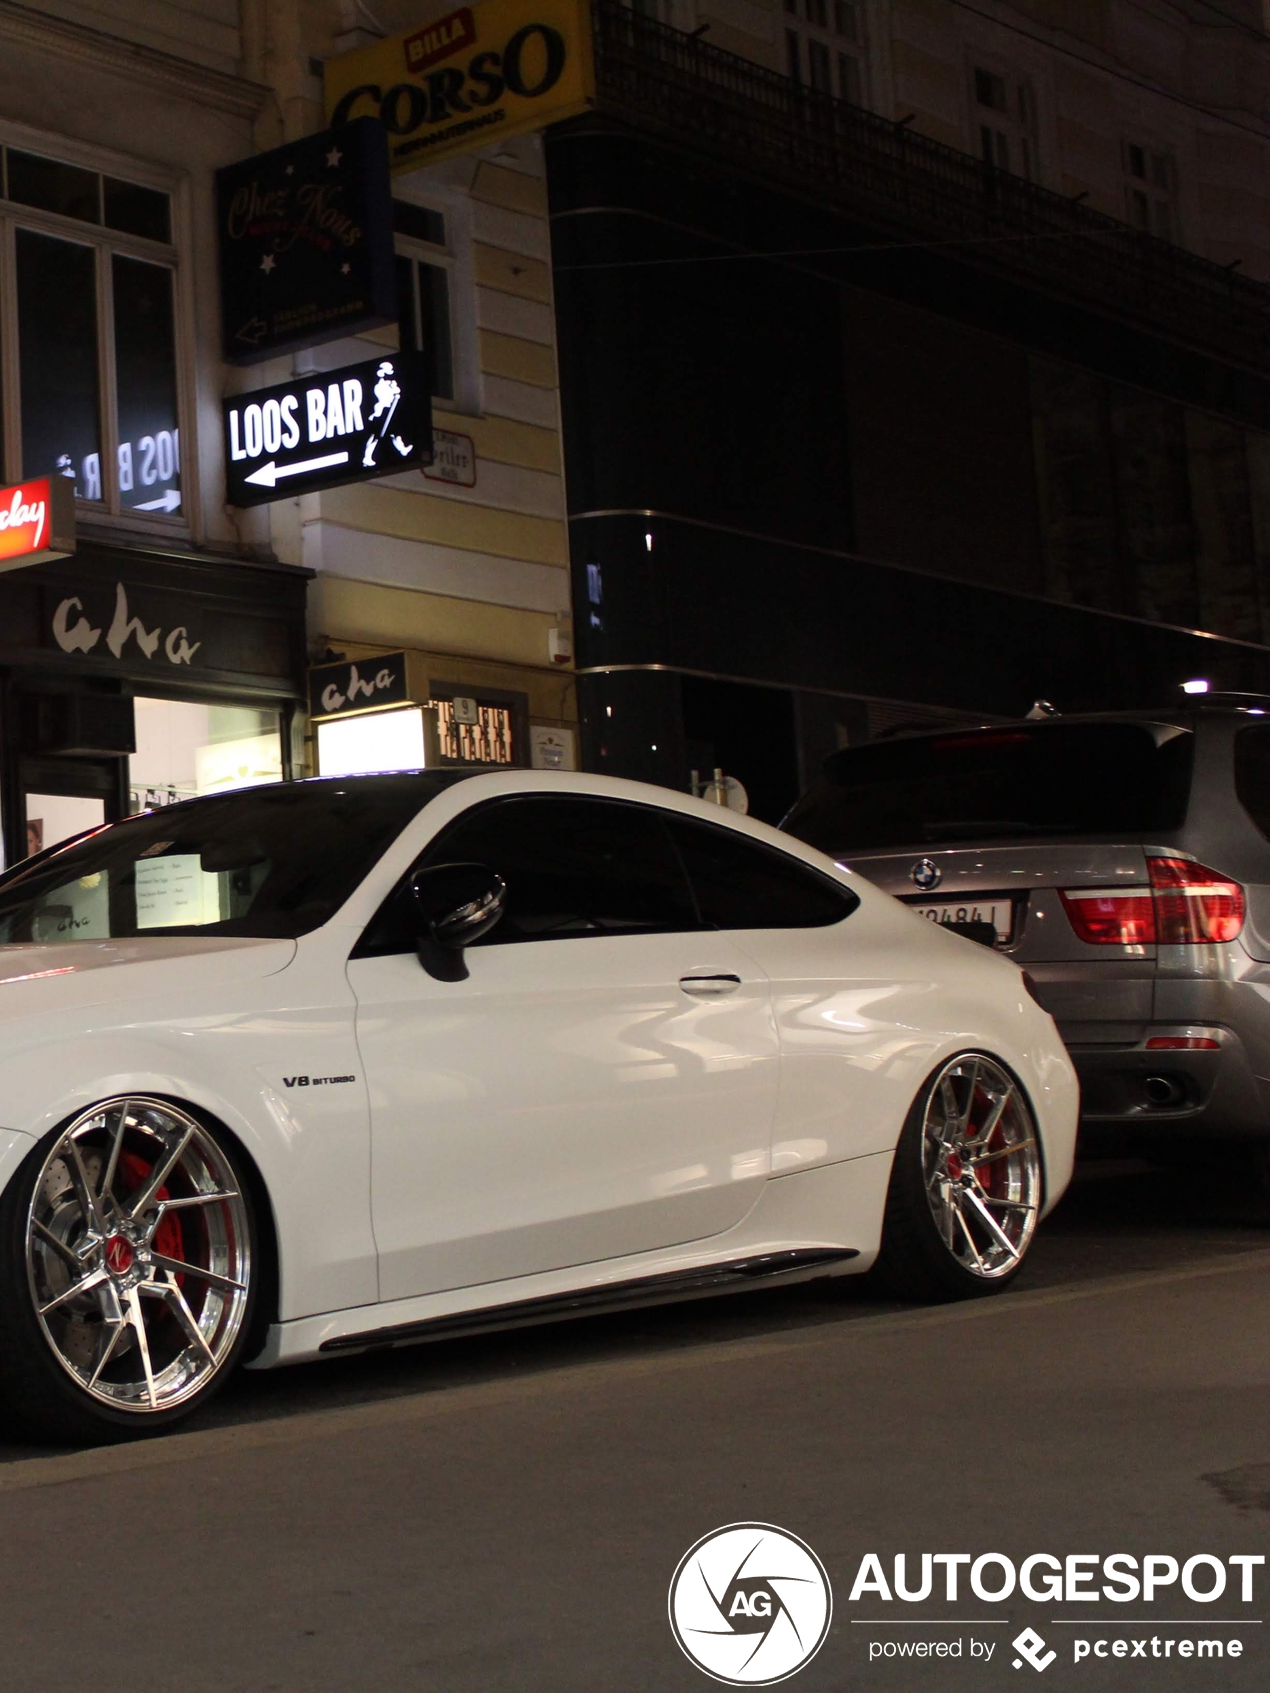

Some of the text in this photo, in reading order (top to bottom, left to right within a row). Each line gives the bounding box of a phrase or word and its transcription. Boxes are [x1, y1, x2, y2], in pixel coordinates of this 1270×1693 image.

[408, 18, 467, 63] BILLA
[331, 23, 566, 134] CORSO
[228, 180, 290, 240] Chez
[229, 378, 365, 462] LOOS BAR
[52, 581, 201, 667] aha
[320, 664, 396, 712] aha
[282, 1075, 356, 1088] V8 BITURBO
